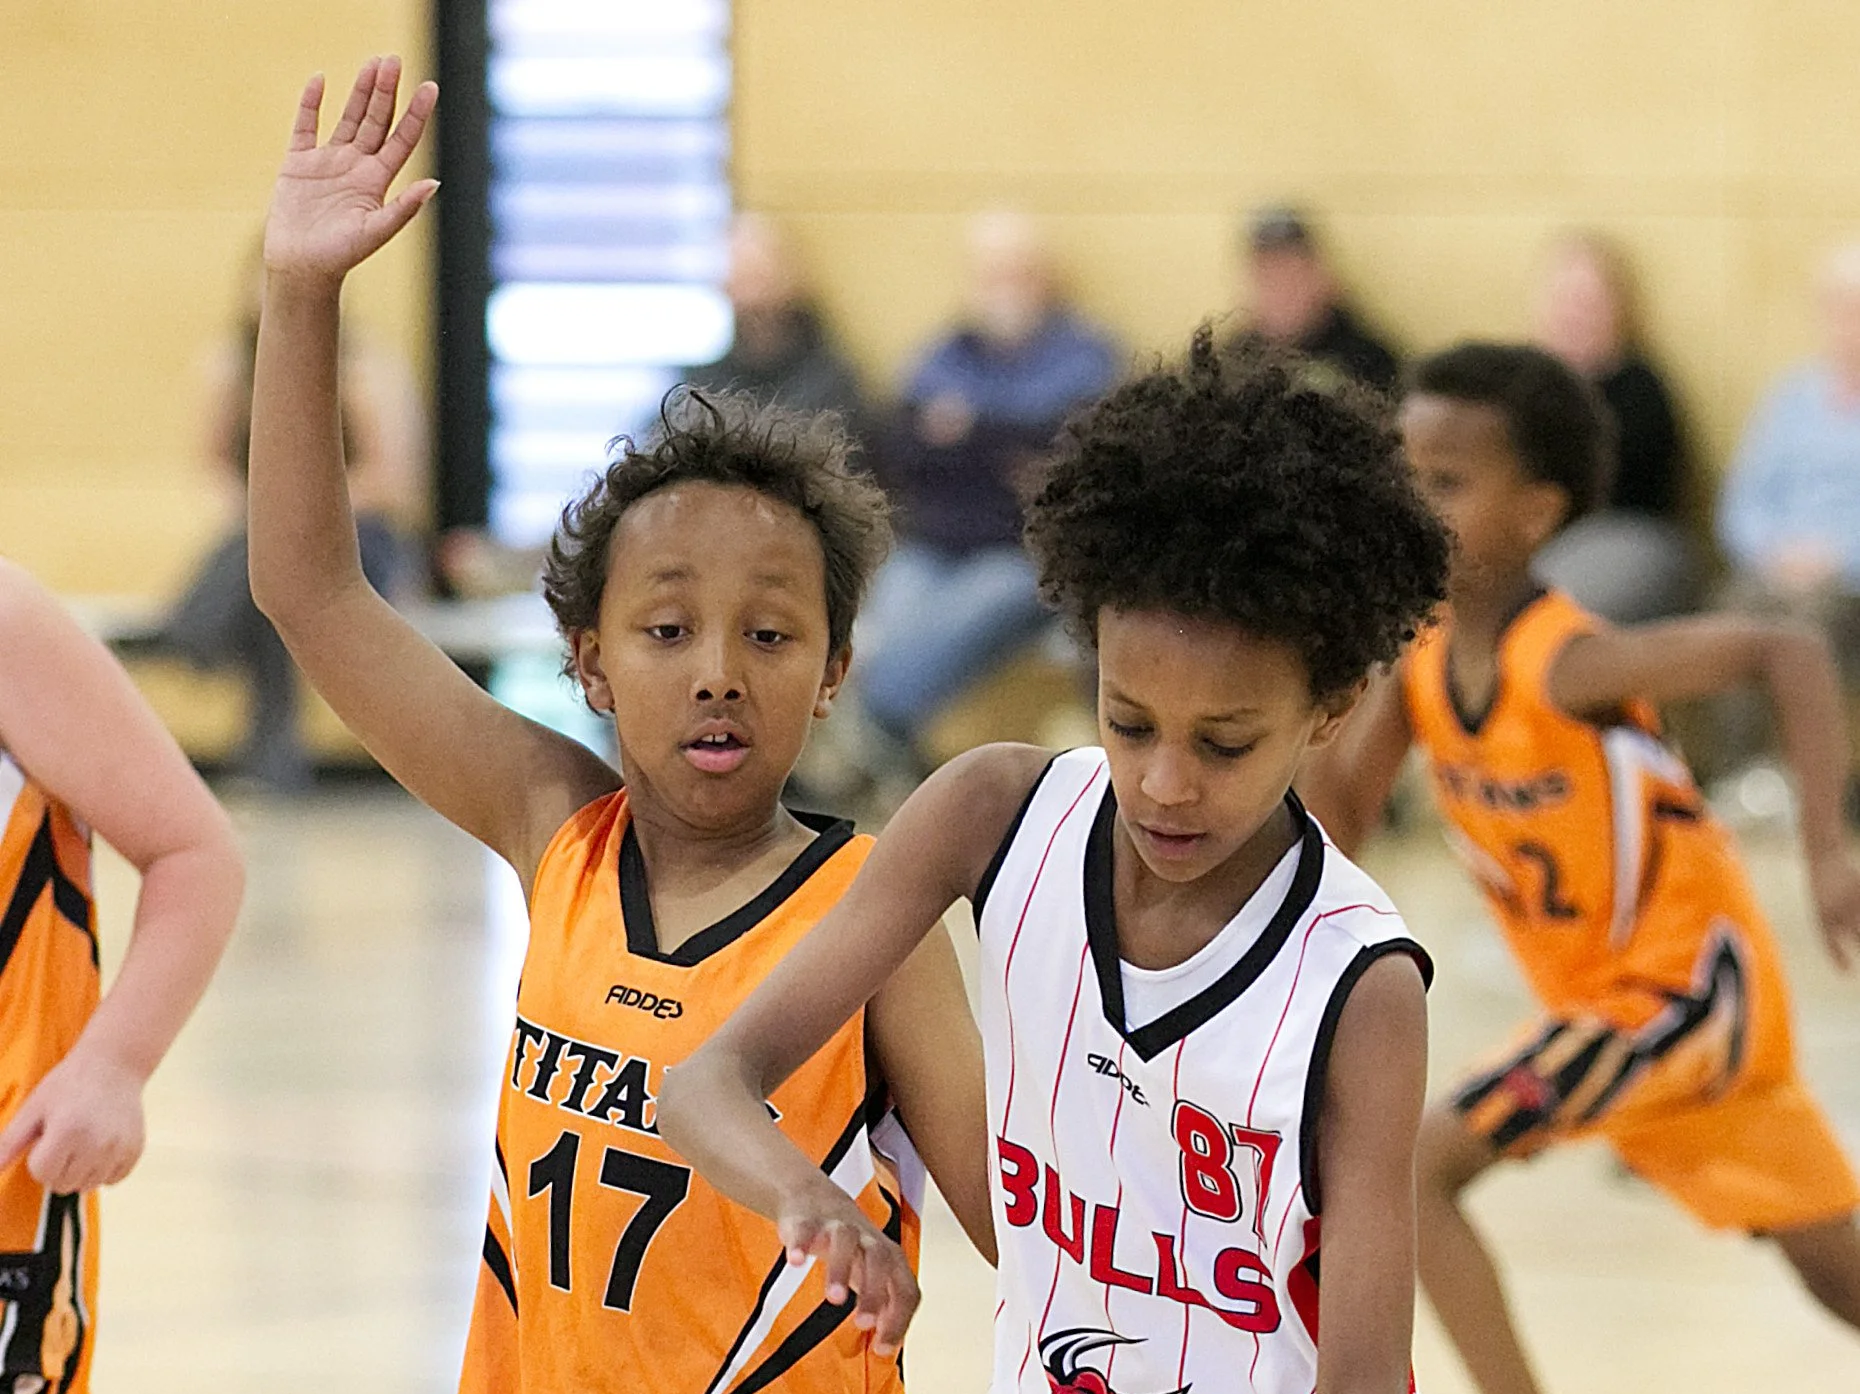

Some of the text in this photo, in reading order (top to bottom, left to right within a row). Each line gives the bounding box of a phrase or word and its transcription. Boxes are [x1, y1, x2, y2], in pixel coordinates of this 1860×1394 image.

[511, 1014, 782, 1138] TITA
[528, 1131, 693, 1314] 17
[996, 1134, 1282, 1333] BULLS
[1171, 1099, 1282, 1248] 87
